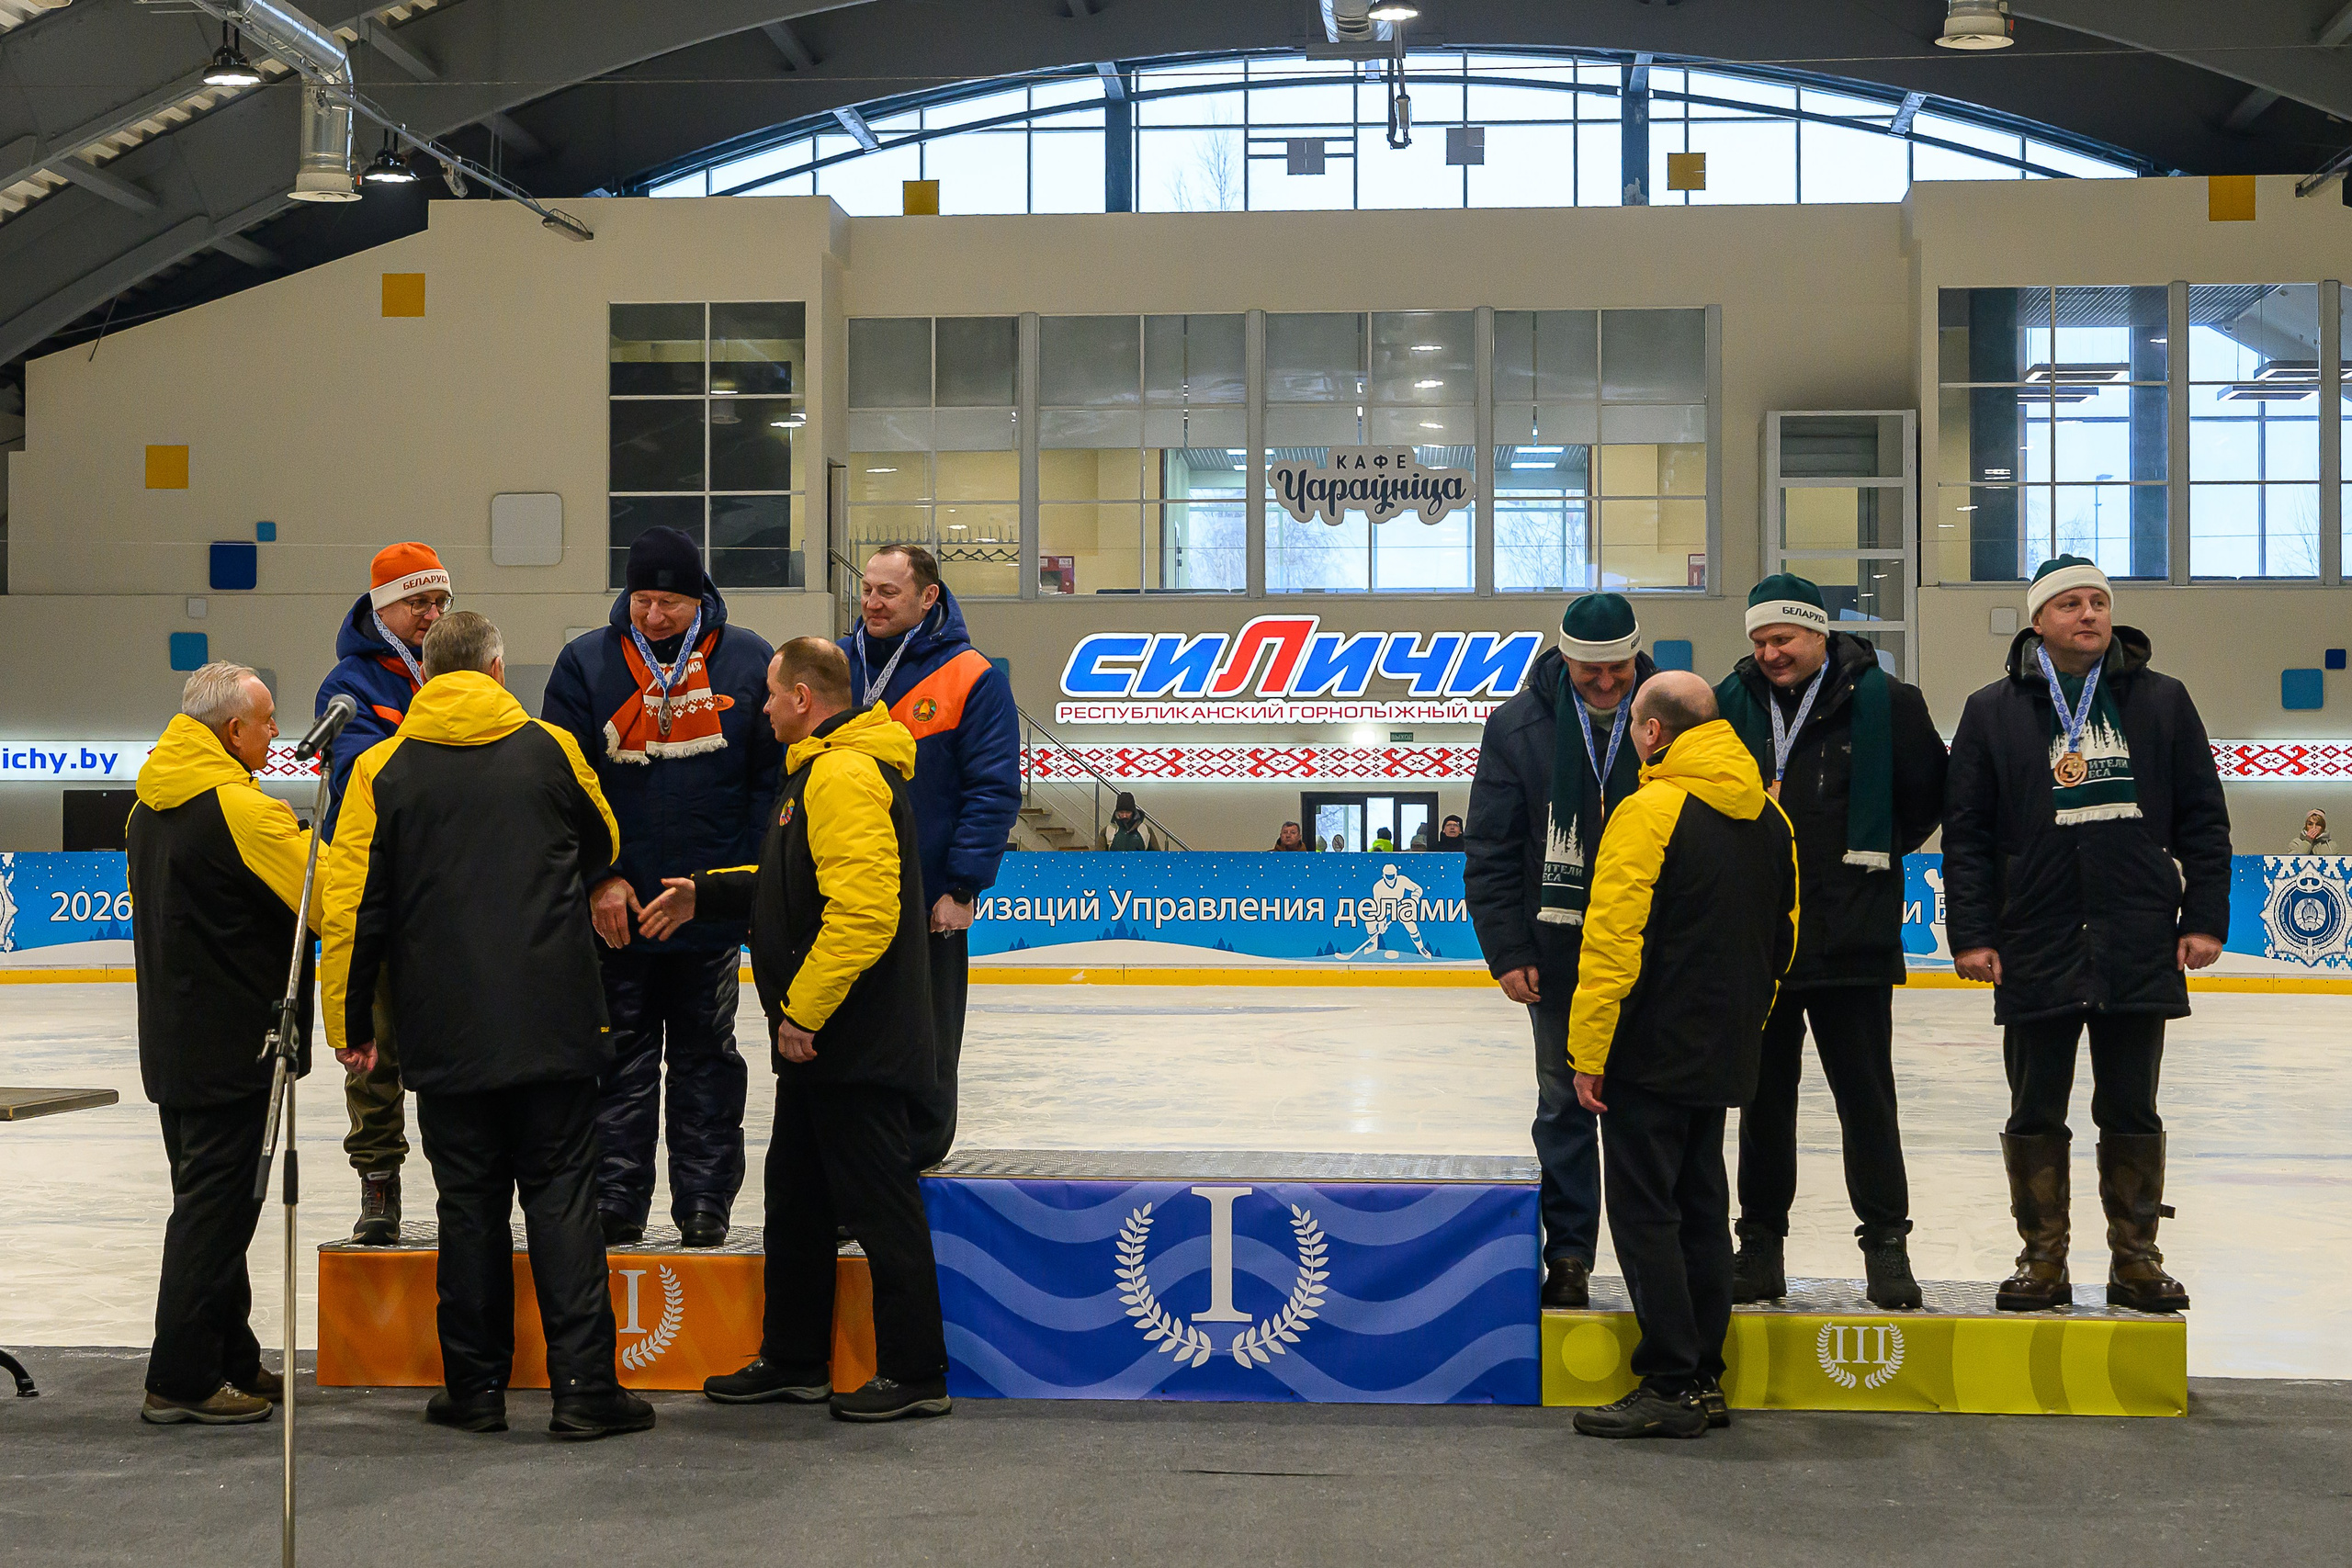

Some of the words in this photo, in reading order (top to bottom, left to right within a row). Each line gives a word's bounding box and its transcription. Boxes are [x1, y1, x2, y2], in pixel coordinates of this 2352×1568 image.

[1336, 454, 1407, 470] КАФЕ
[1276, 468, 1467, 516] Чараўніца
[1781, 606, 1826, 625] БЕЛАРУСЬ
[1059, 703, 1283, 719] РЕСПУБЛИКАНСКИЙ
[1289, 703, 1468, 719] ГОРНОЛЫЖНЫЙ
[49, 890, 134, 922] 2026
[1107, 888, 1326, 930] Управления
[1333, 897, 1469, 929] делами
[1190, 1186, 1253, 1323] I
[1830, 1325, 1891, 1365] III
